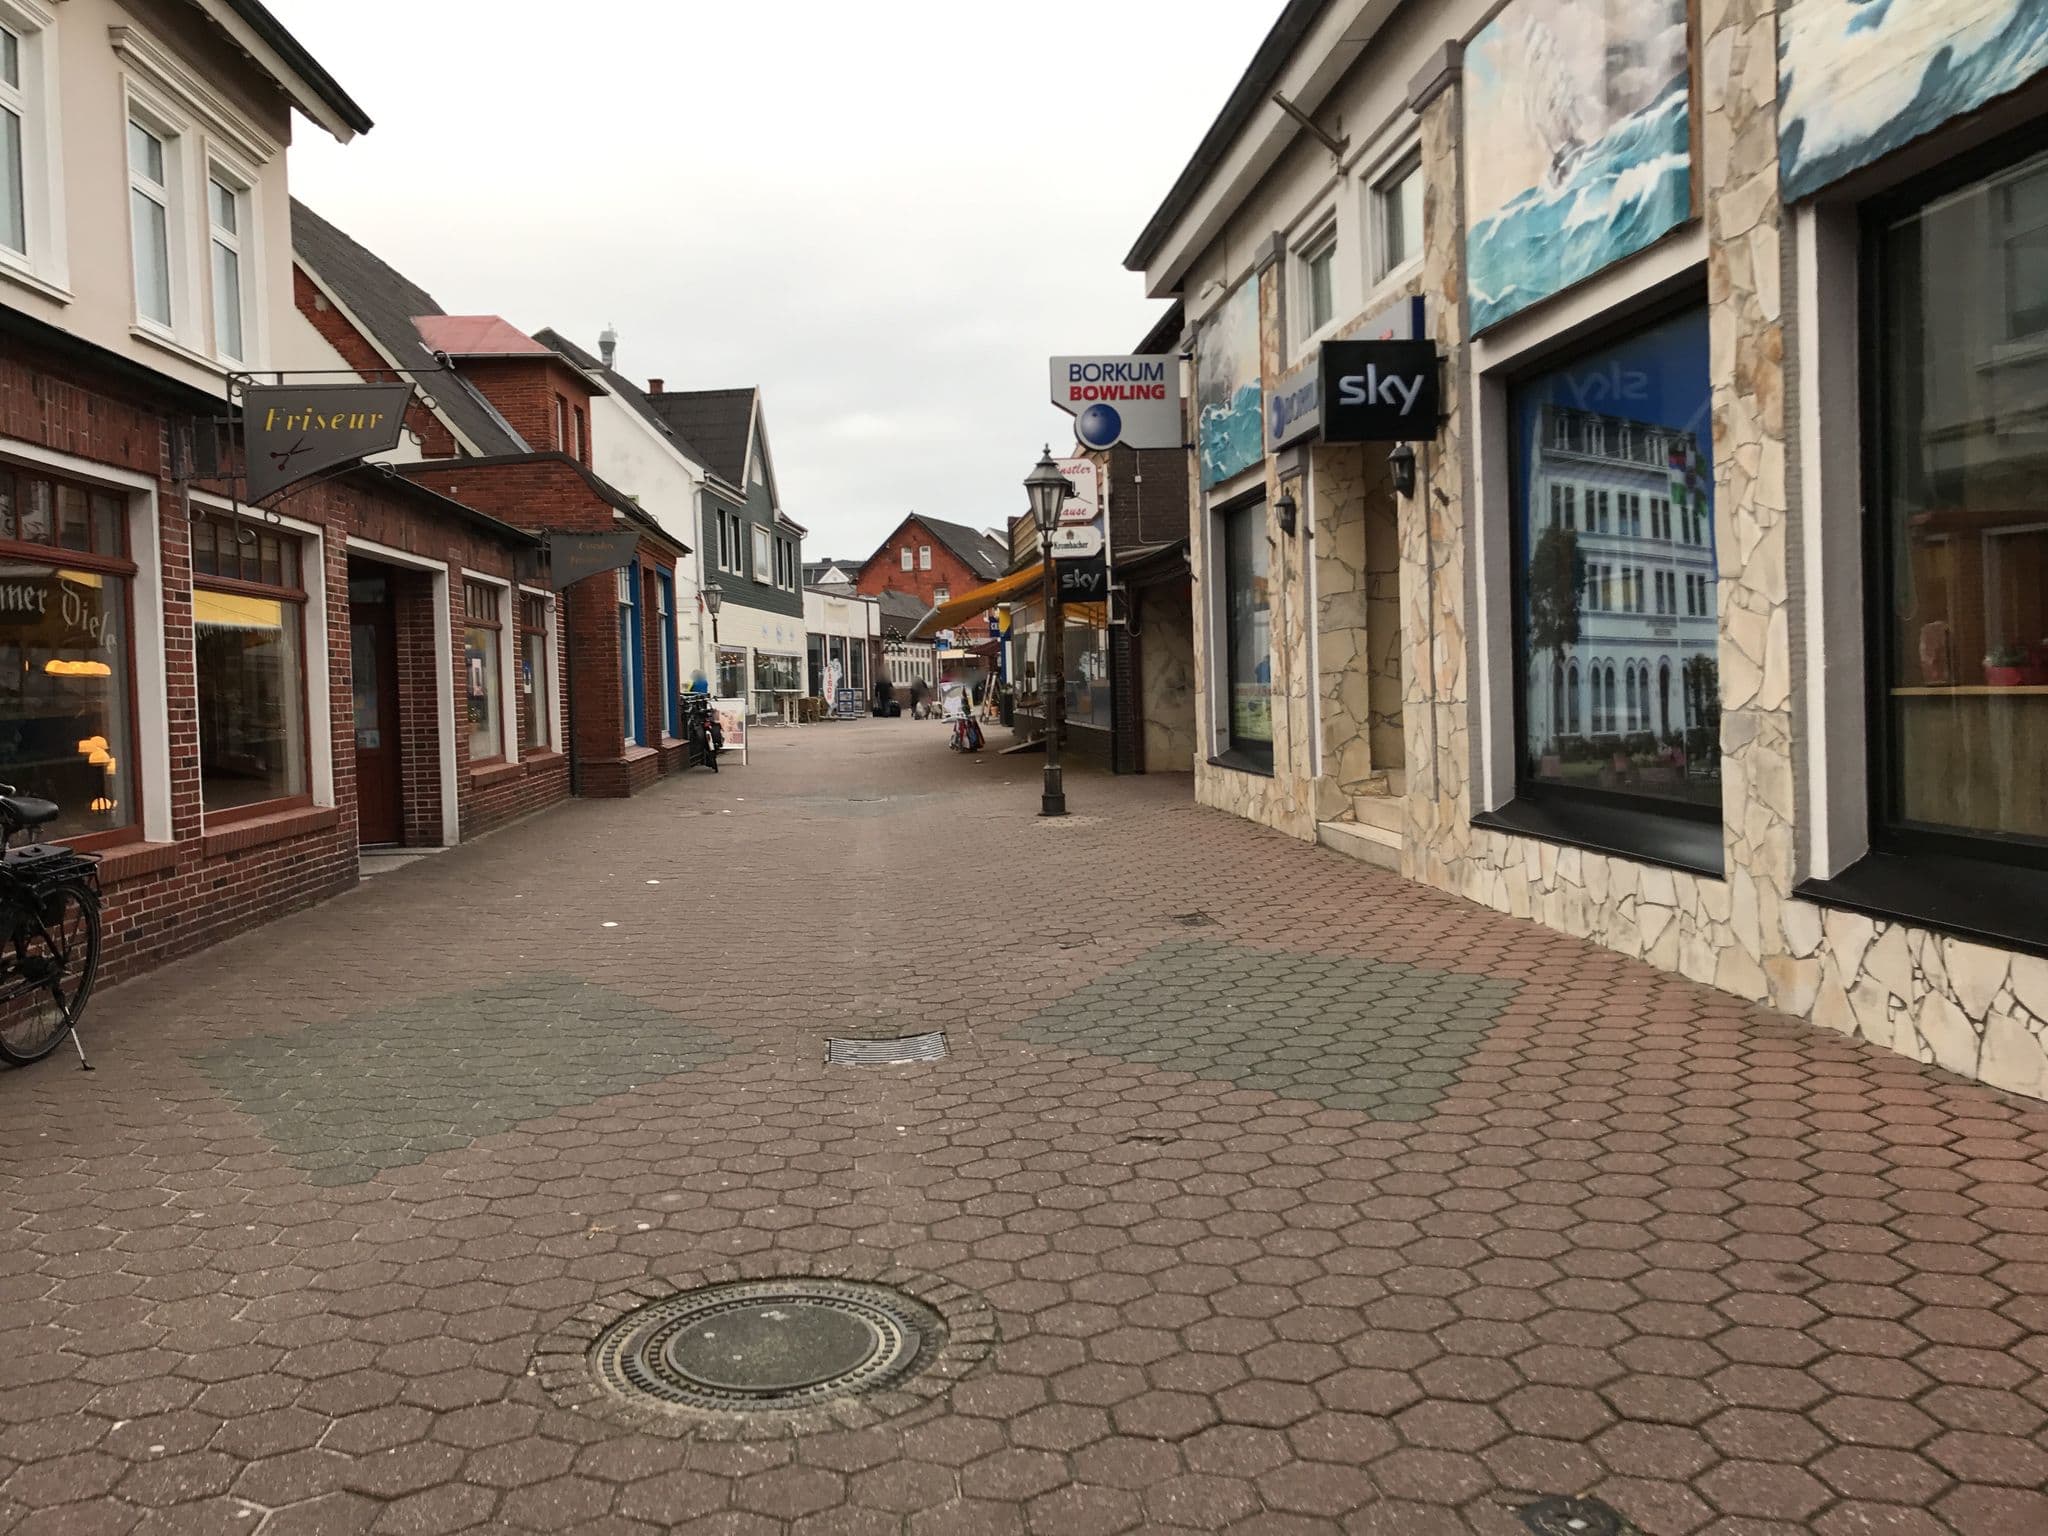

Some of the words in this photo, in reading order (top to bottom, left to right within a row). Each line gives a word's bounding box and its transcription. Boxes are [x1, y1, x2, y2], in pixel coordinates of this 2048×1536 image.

[1069, 362, 1164, 382] BORKUM
[1069, 384, 1166, 401] BOWLING
[1338, 363, 1425, 415] sky
[265, 407, 384, 432] Friseur
[1057, 464, 1092, 475] nstler
[1062, 506, 1087, 517] ause
[1062, 568, 1100, 592] sky
